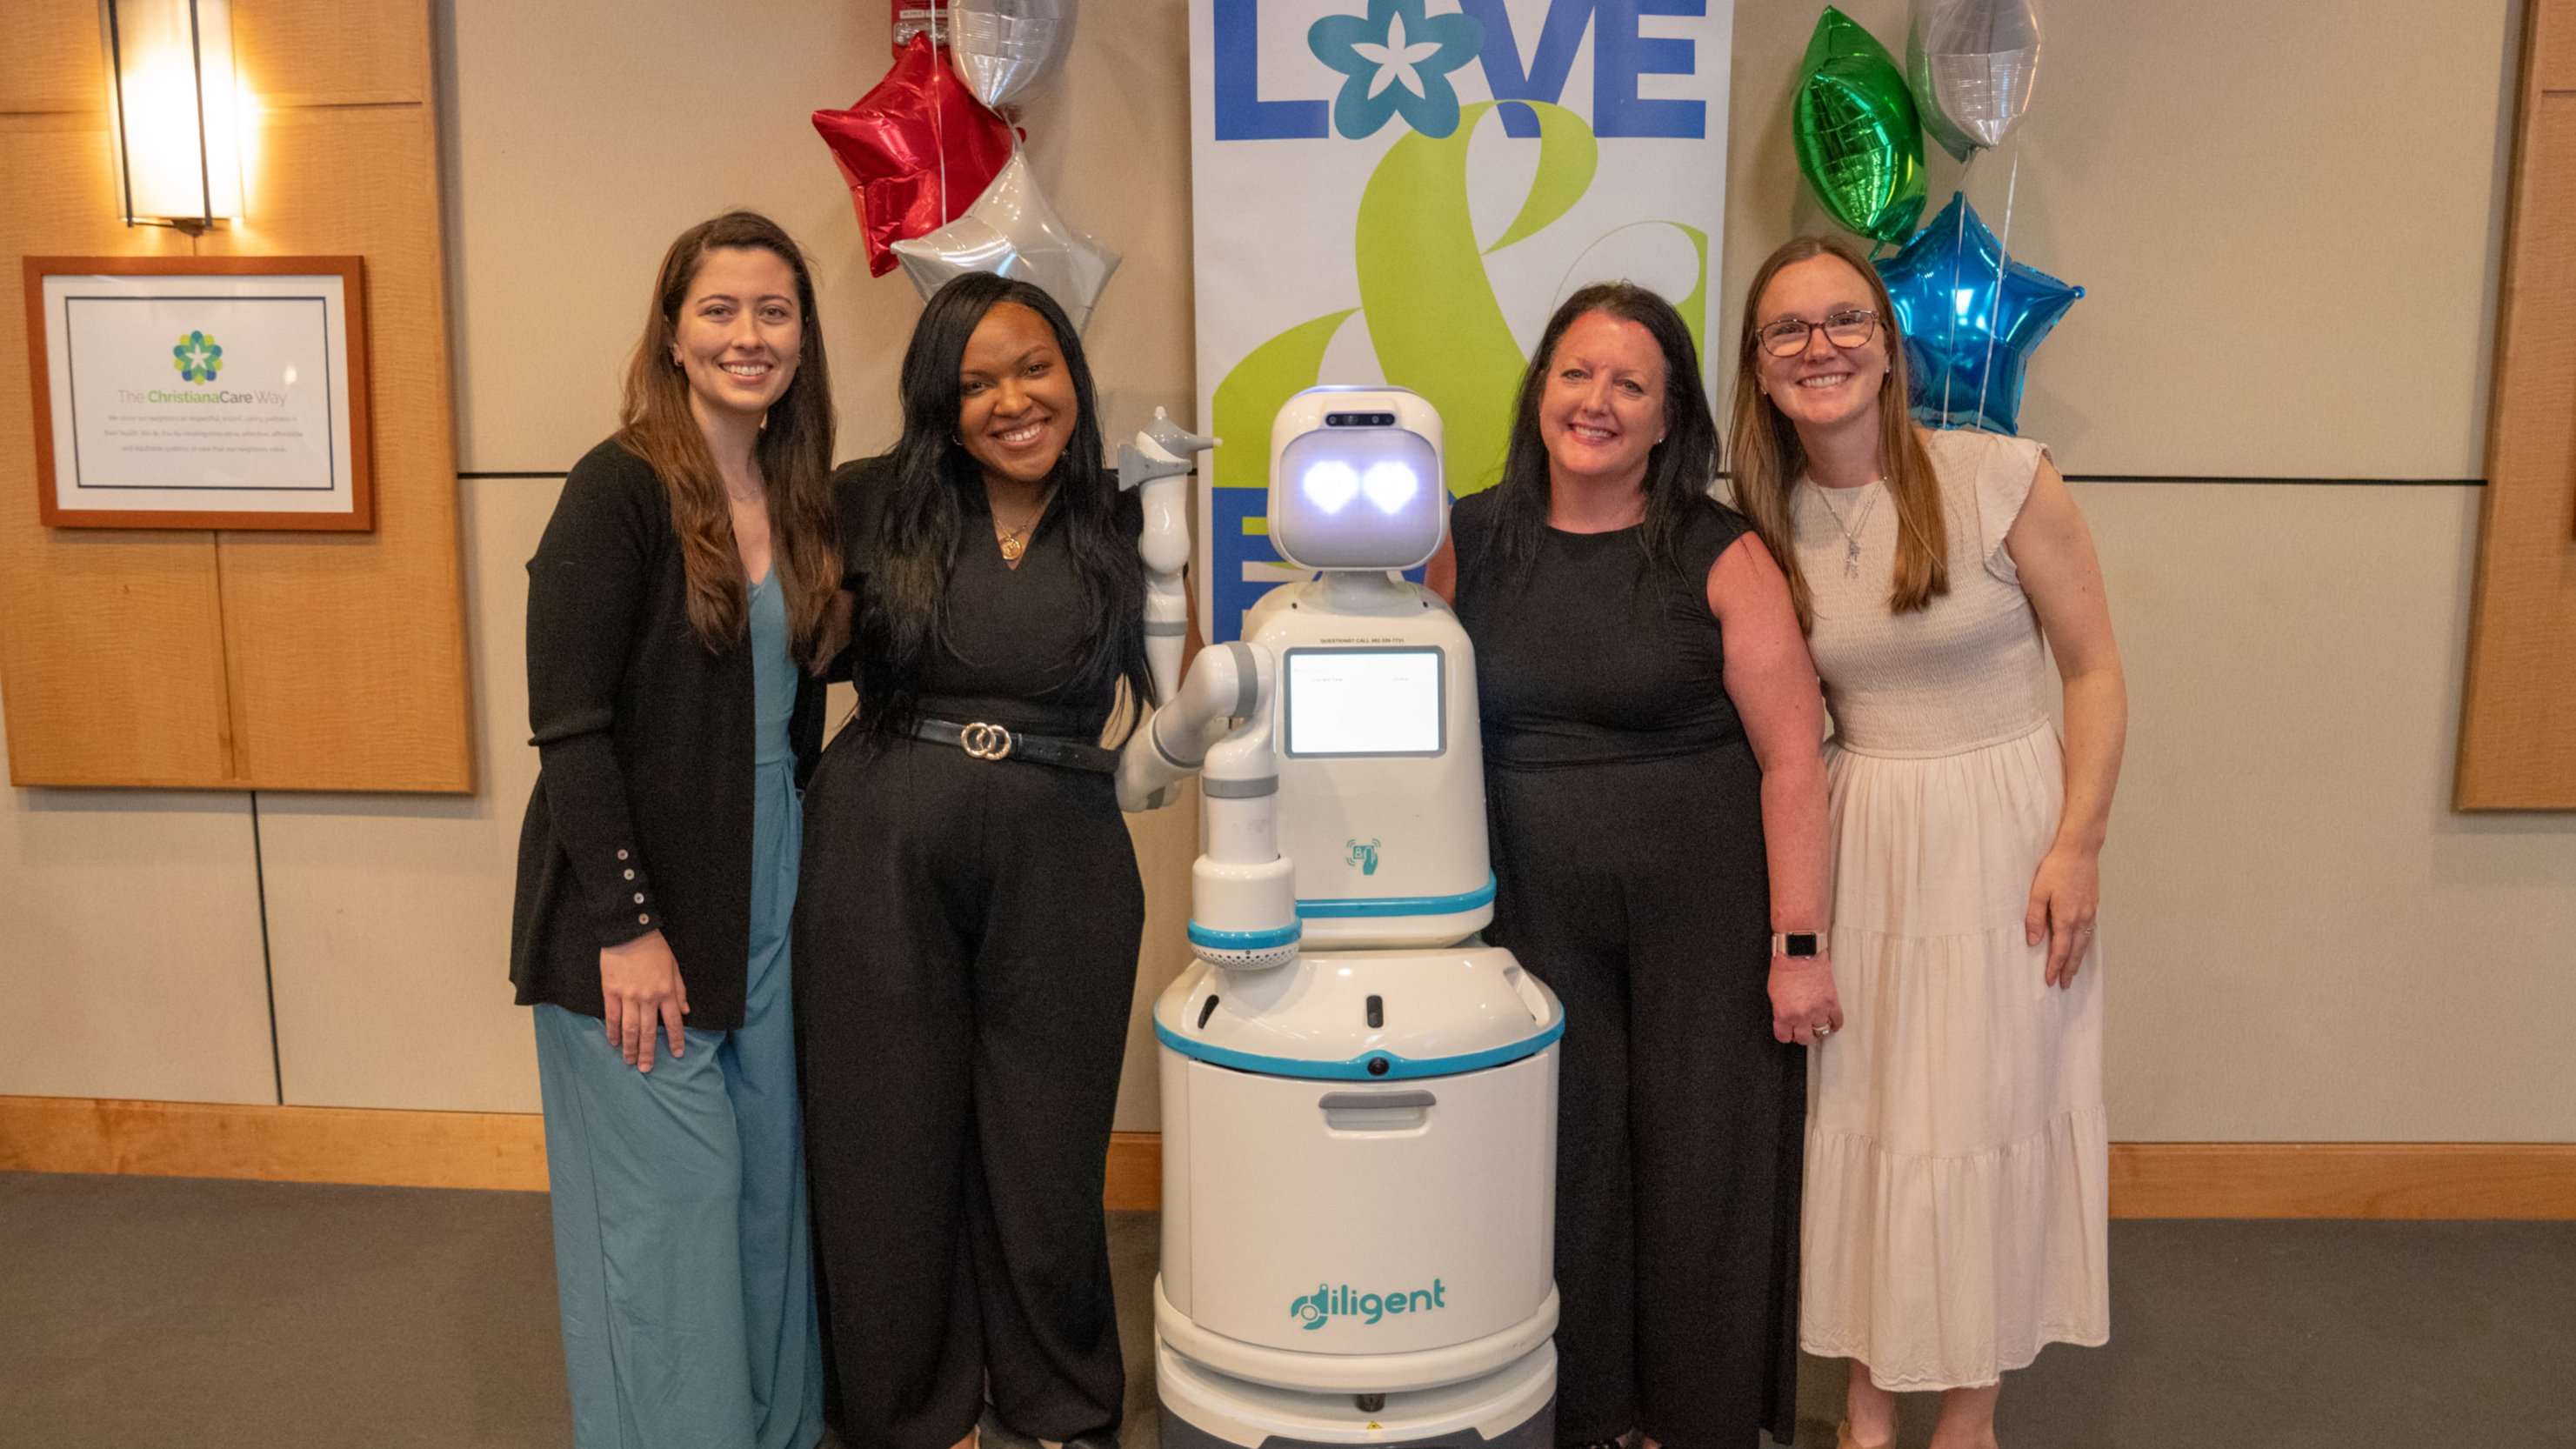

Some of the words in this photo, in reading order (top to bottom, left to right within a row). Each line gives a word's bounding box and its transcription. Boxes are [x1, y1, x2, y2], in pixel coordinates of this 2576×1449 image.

[117, 390, 145, 404] The
[148, 390, 254, 404] ChristianaCare
[254, 390, 287, 407] Way
